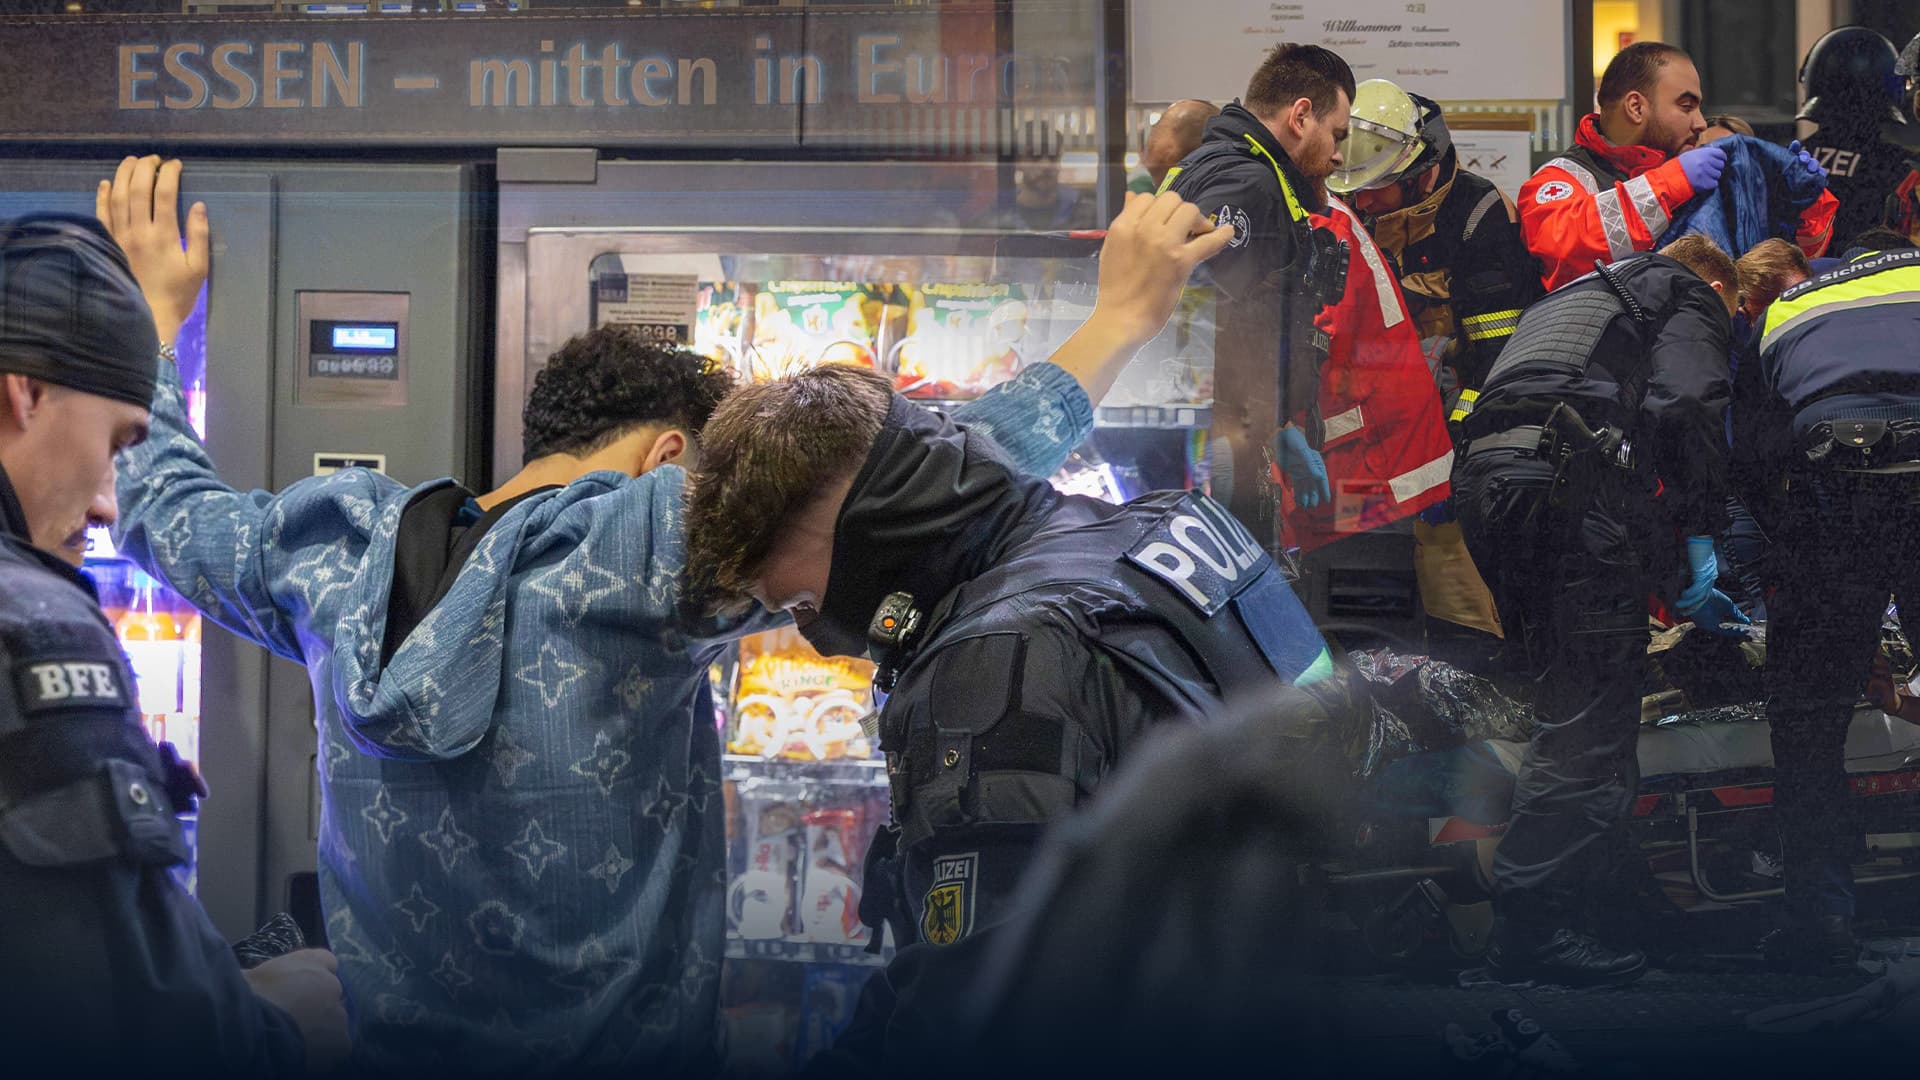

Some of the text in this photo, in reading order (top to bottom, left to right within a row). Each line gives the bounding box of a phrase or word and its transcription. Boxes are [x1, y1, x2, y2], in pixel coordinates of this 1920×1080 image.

[1322, 19, 1402, 33] Willkommen
[118, 41, 364, 110] ESSEN
[469, 39, 718, 107] mitten
[754, 37, 821, 105] in
[1135, 496, 1265, 607] POLI
[31, 662, 118, 699] BFE
[934, 858, 970, 882] LIZEI
